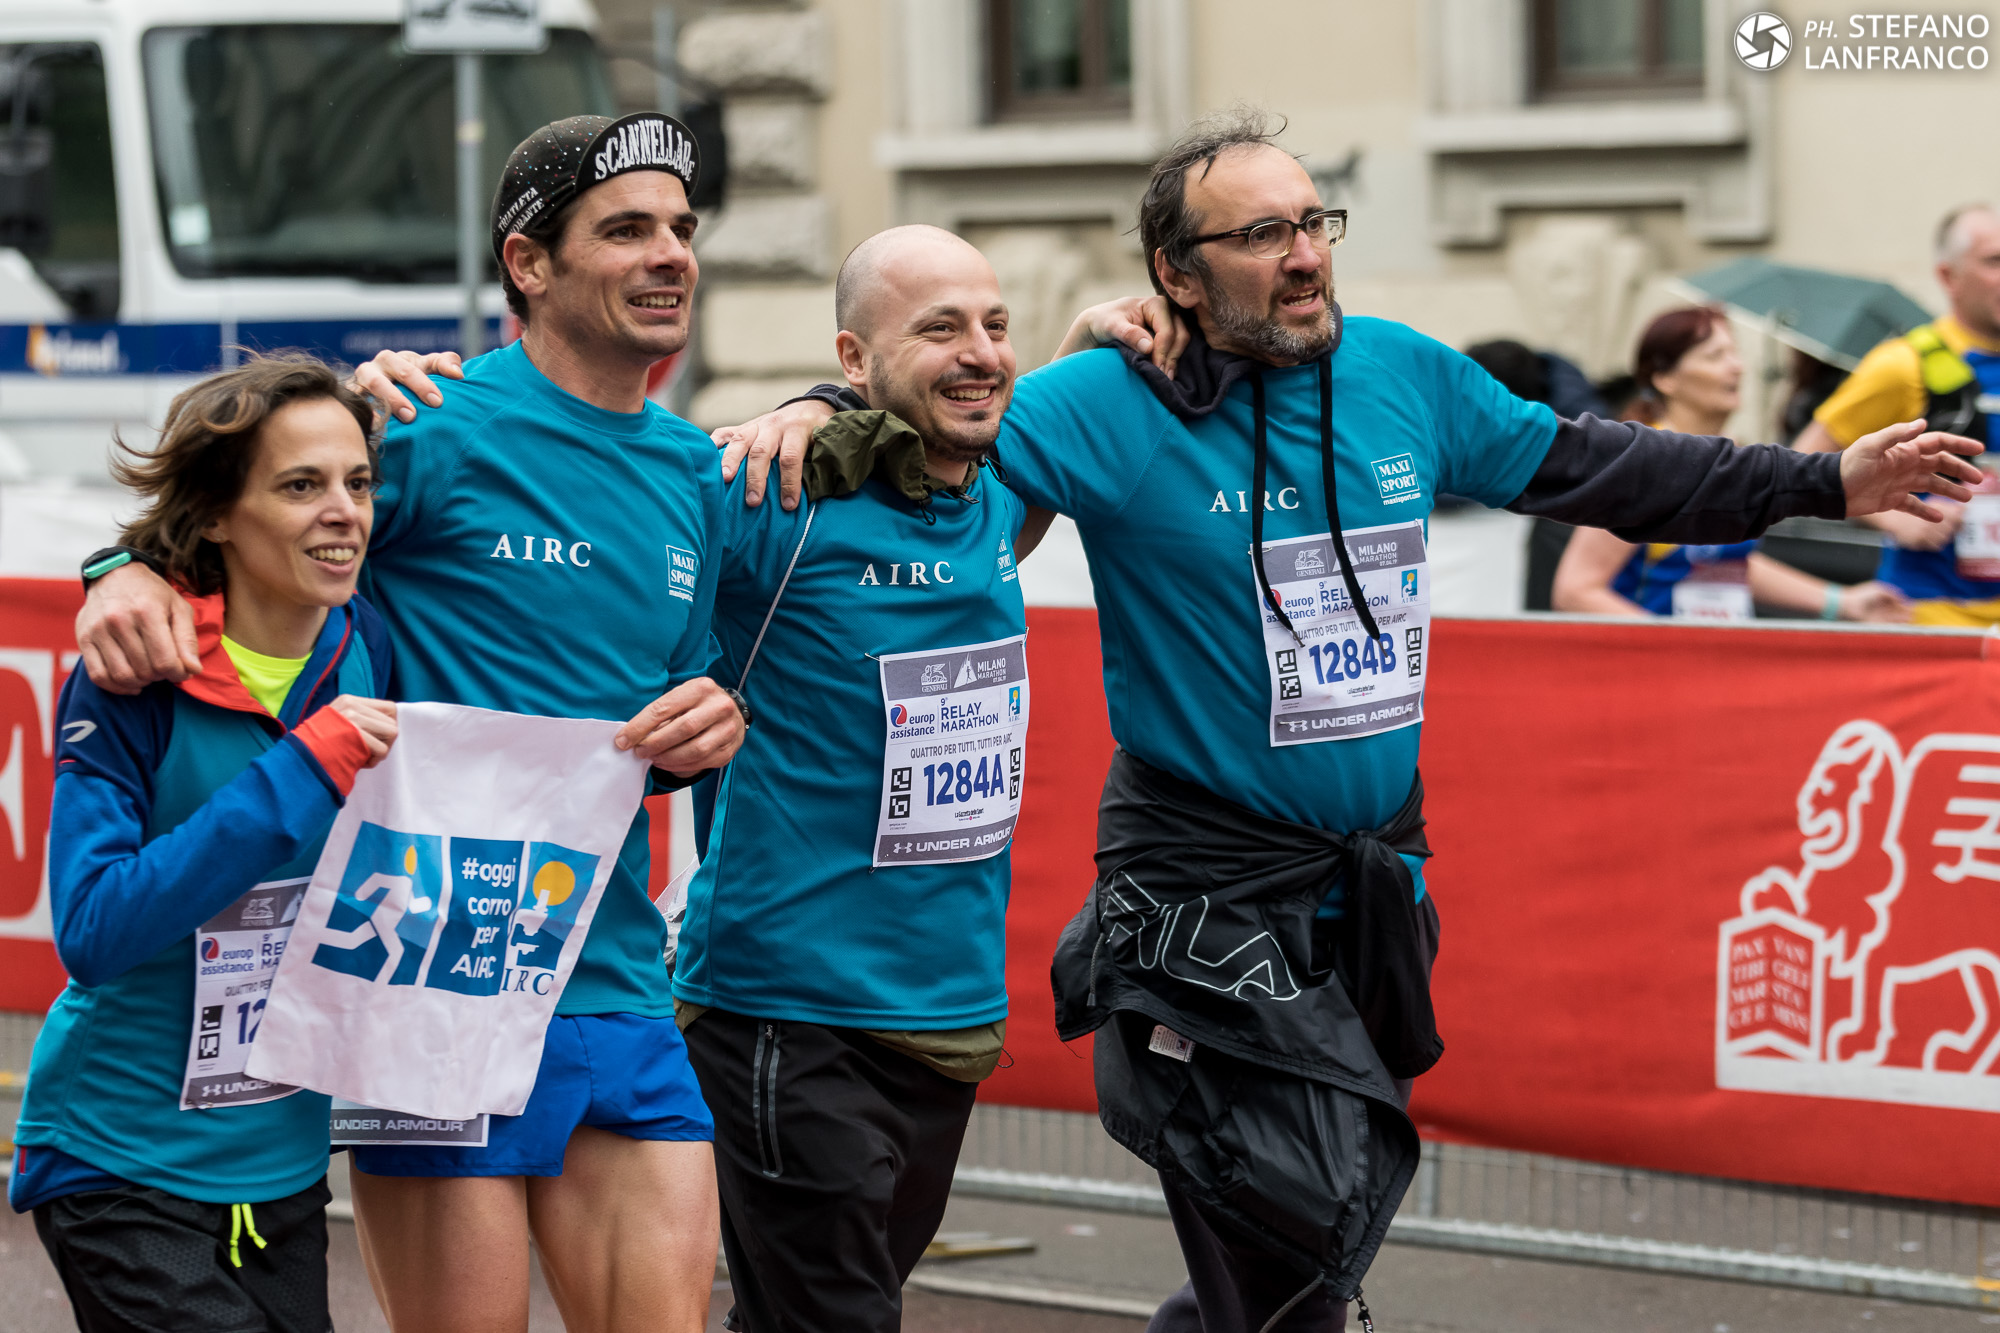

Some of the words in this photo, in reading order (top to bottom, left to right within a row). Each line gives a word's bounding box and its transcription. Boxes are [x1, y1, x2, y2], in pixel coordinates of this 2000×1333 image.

[595, 119, 695, 181] SCANNELLARE
[498, 187, 539, 232] TRIATLETA
[1378, 459, 1411, 477] MAXI
[1381, 473, 1416, 492] SPORT
[1383, 492, 1421, 505] maxisport.com
[490, 534, 591, 567] AIRC
[1358, 542, 1397, 556] MILANO
[1360, 552, 1397, 563] MARATHON
[672, 553, 695, 572] MAXI
[1296, 567, 1325, 577] GENERALI
[671, 569, 695, 588] SPORT
[858, 561, 953, 586] AIRC
[1285, 596, 1314, 610] europ
[1266, 606, 1316, 623] asstance
[1325, 625, 1339, 636] PER
[1377, 615, 1392, 626] PER
[978, 658, 1006, 673] MILANO
[1309, 632, 1397, 685] 1284B
[978, 668, 1006, 680] MARATHON
[922, 684, 948, 693] GENERALI
[909, 713, 935, 725] europ
[941, 702, 982, 721] RELAY
[1312, 713, 1366, 730] UNDER
[1370, 702, 1415, 722] ARMOUR
[941, 713, 999, 733] MARATHON
[890, 726, 935, 740] assistance
[911, 745, 942, 759] QUATTRO
[944, 744, 957, 755] PER
[977, 737, 993, 749] TUTTI
[993, 735, 1002, 747] PER
[924, 754, 1004, 806] 1284A
[916, 838, 970, 852] UNDER
[974, 826, 1011, 847] ARMOUR
[462, 857, 516, 888] #oggi
[468, 897, 512, 916] corro
[470, 926, 500, 948] per
[222, 949, 254, 961] europ
[201, 962, 254, 976] assistance
[334, 1119, 380, 1131] UNDER
[385, 1119, 464, 1132] ARMOUR
